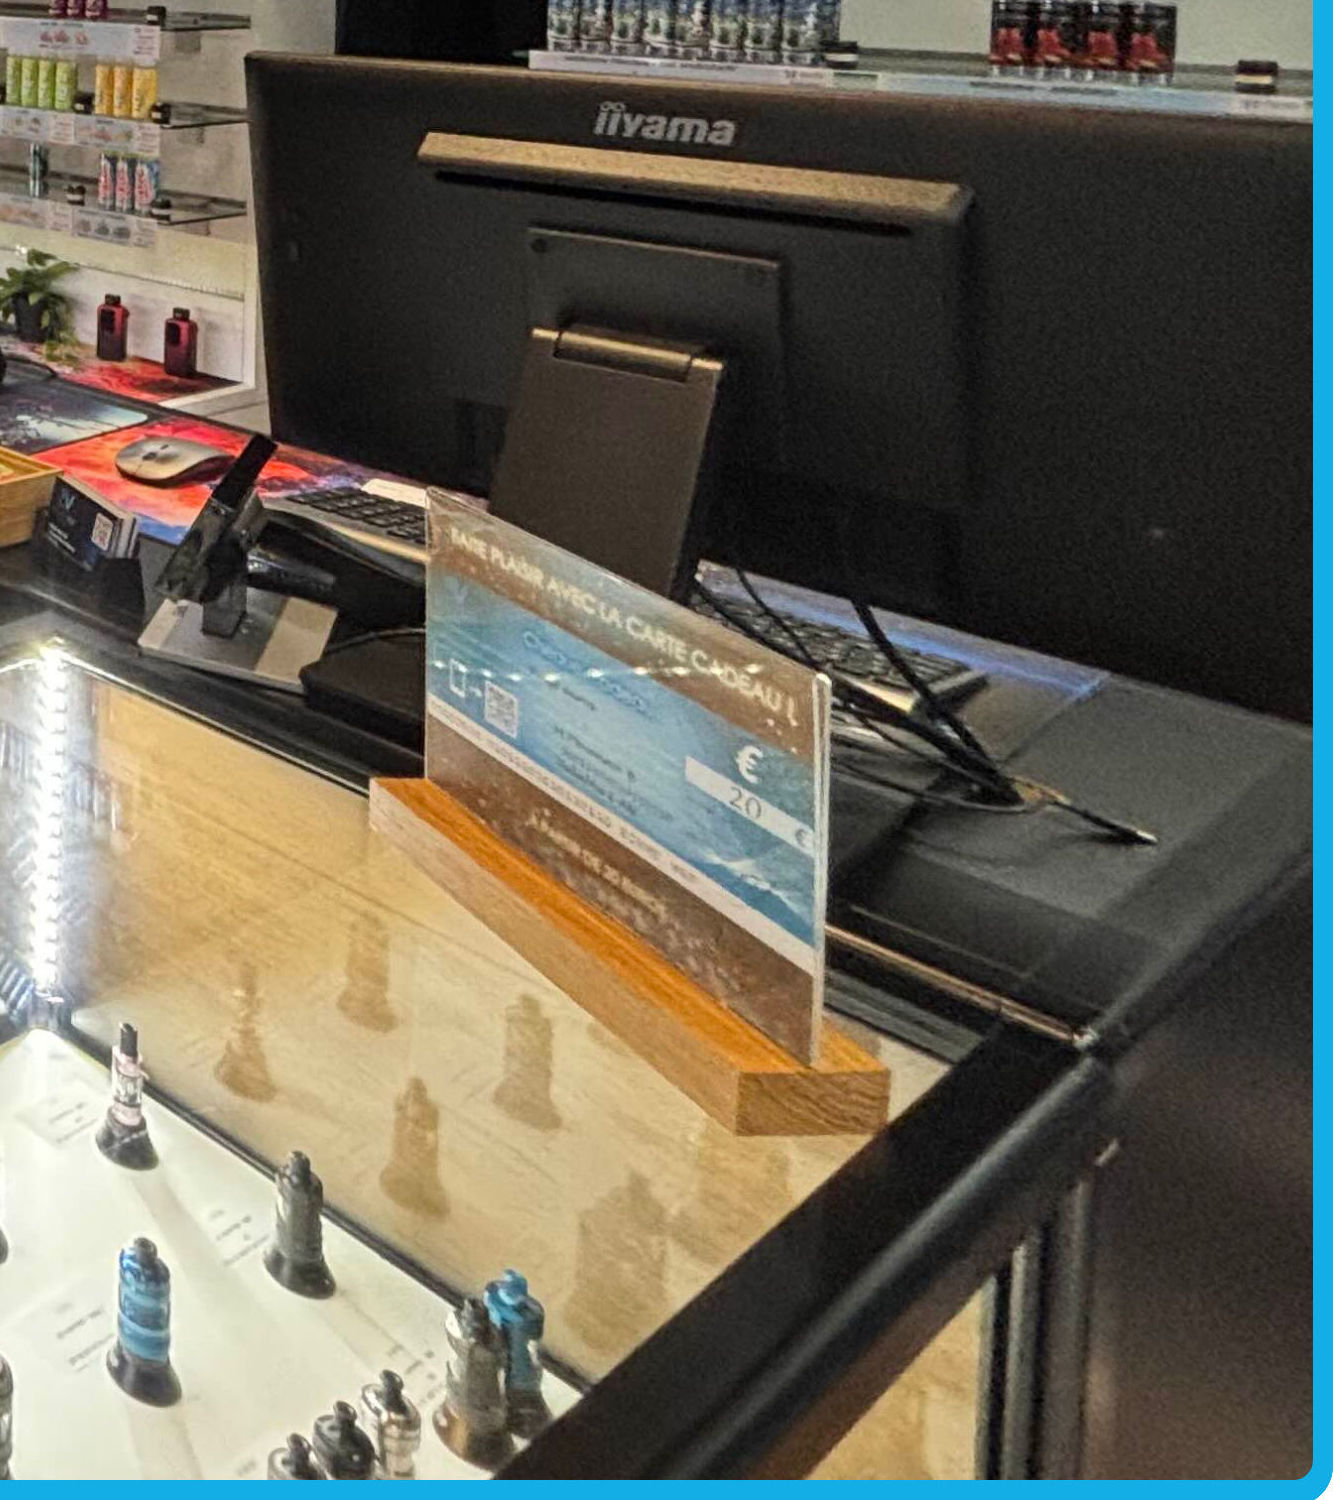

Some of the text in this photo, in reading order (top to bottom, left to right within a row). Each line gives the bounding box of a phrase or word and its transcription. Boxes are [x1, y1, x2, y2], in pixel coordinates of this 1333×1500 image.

[593, 101, 736, 147] iiyama
[491, 546, 546, 589] PLAISIR
[545, 577, 596, 616] AVEC
[598, 606, 622, 629] LA
[625, 615, 689, 663] CARTE
[689, 649, 783, 714] CADEAU
[729, 786, 763, 821] 20
